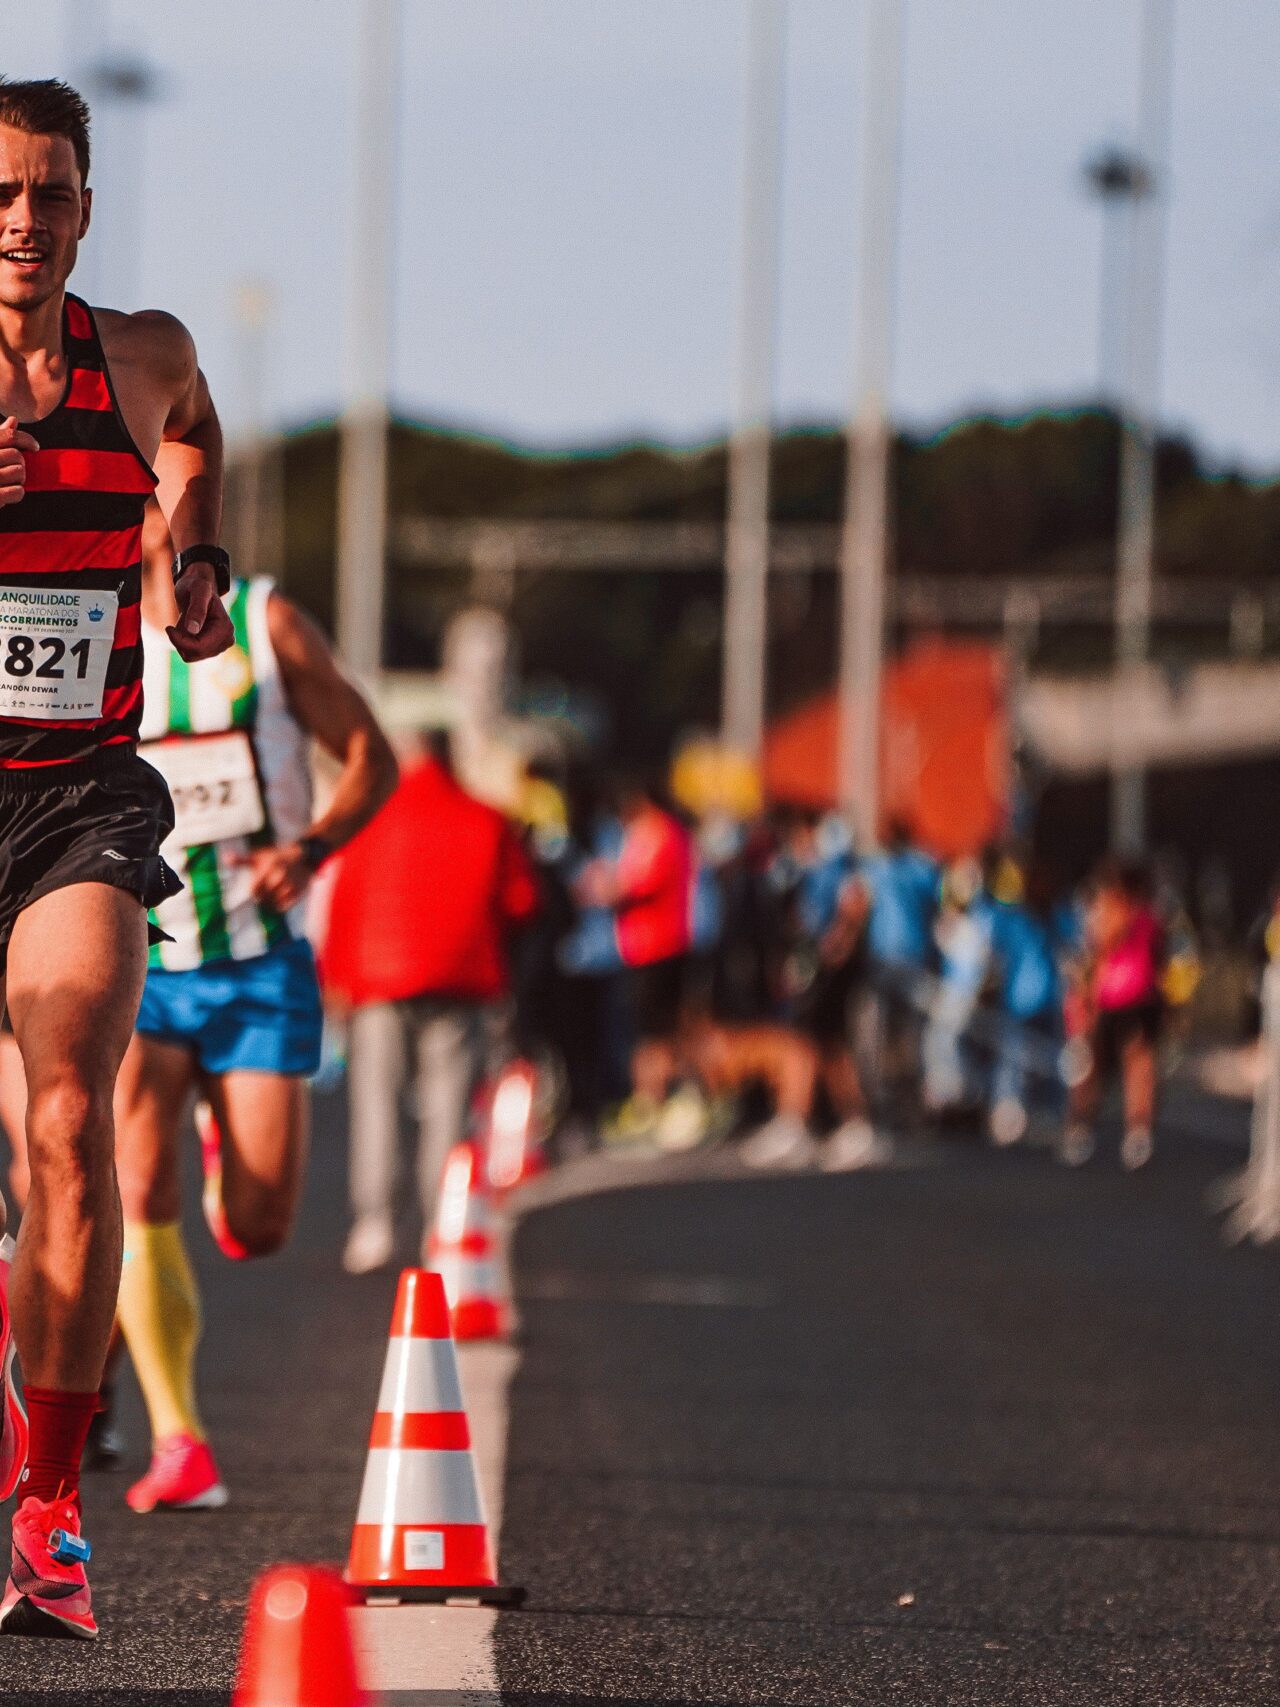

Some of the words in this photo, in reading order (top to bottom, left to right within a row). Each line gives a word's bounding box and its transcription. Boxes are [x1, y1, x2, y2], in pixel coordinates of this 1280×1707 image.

[8, 606, 59, 617] MARATONA
[61, 609, 80, 618] DOS
[31, 685, 58, 694] DEWAR
